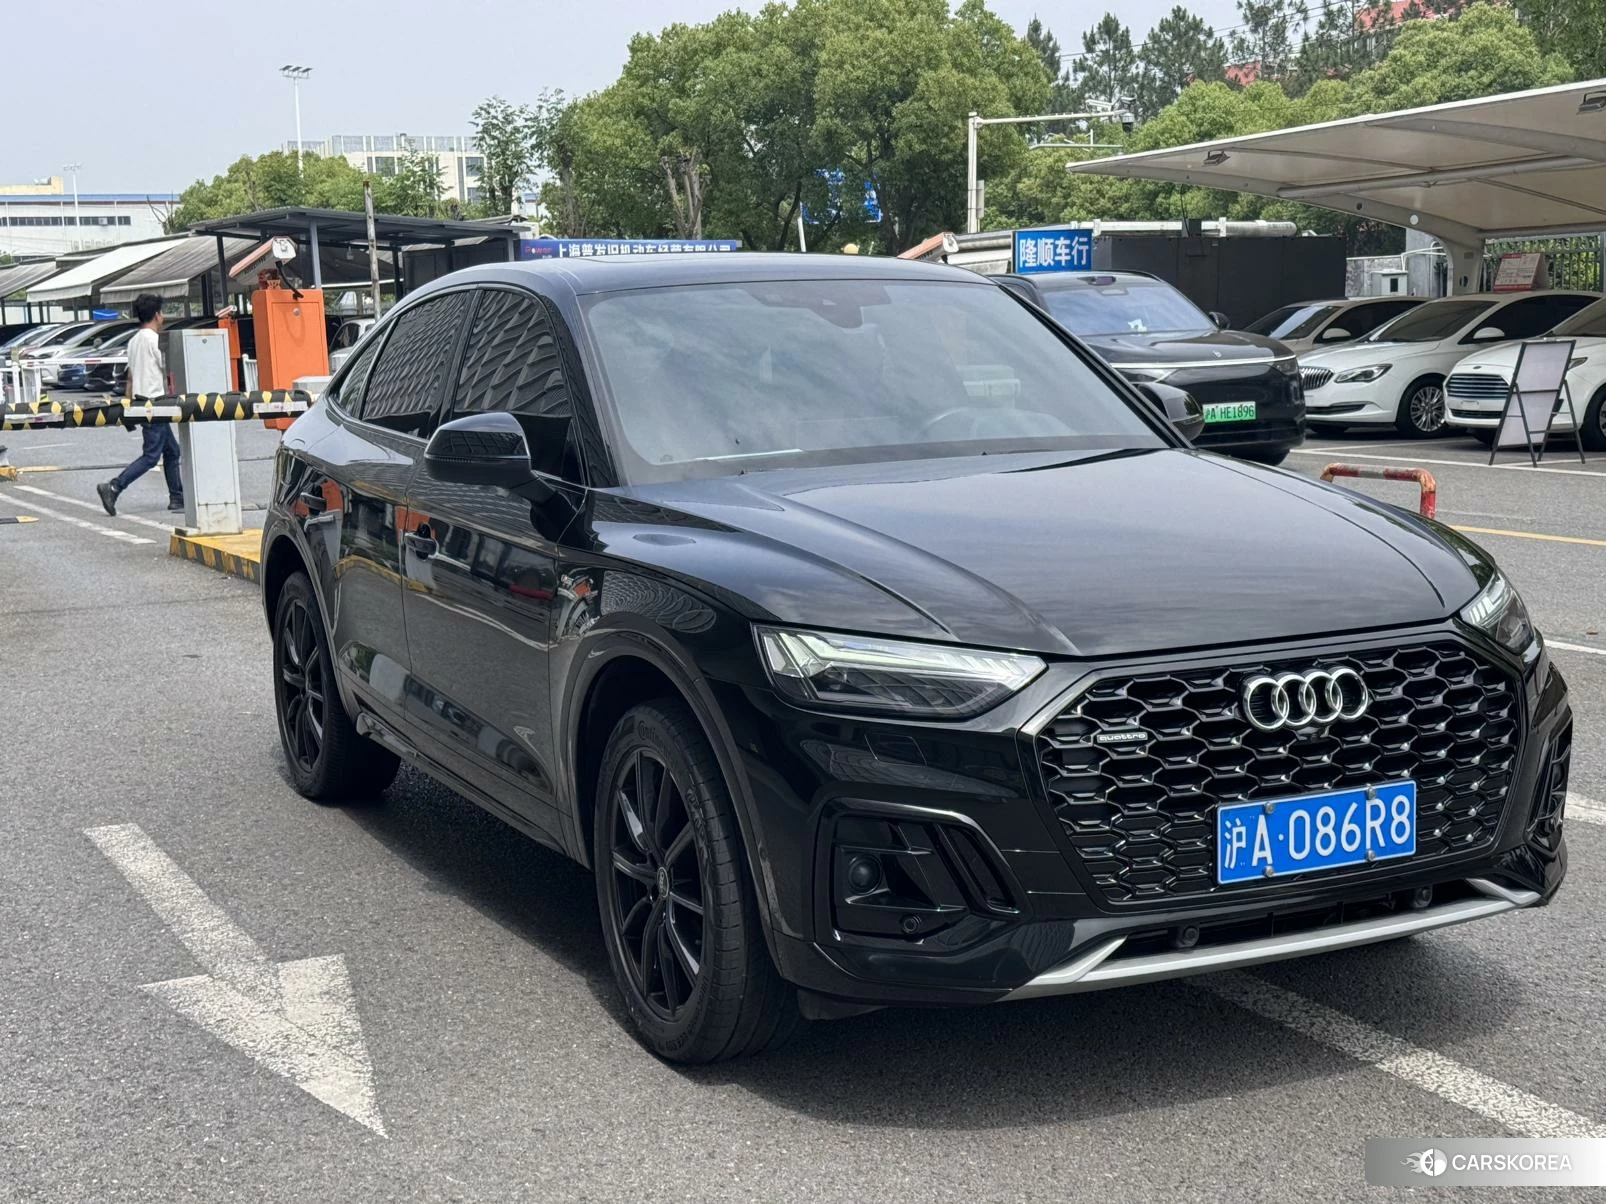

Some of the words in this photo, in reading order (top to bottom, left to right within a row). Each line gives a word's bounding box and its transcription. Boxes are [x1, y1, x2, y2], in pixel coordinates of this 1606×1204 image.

[1019, 236, 1089, 268] 隆顺车行
[1099, 733, 1146, 742] quattro
